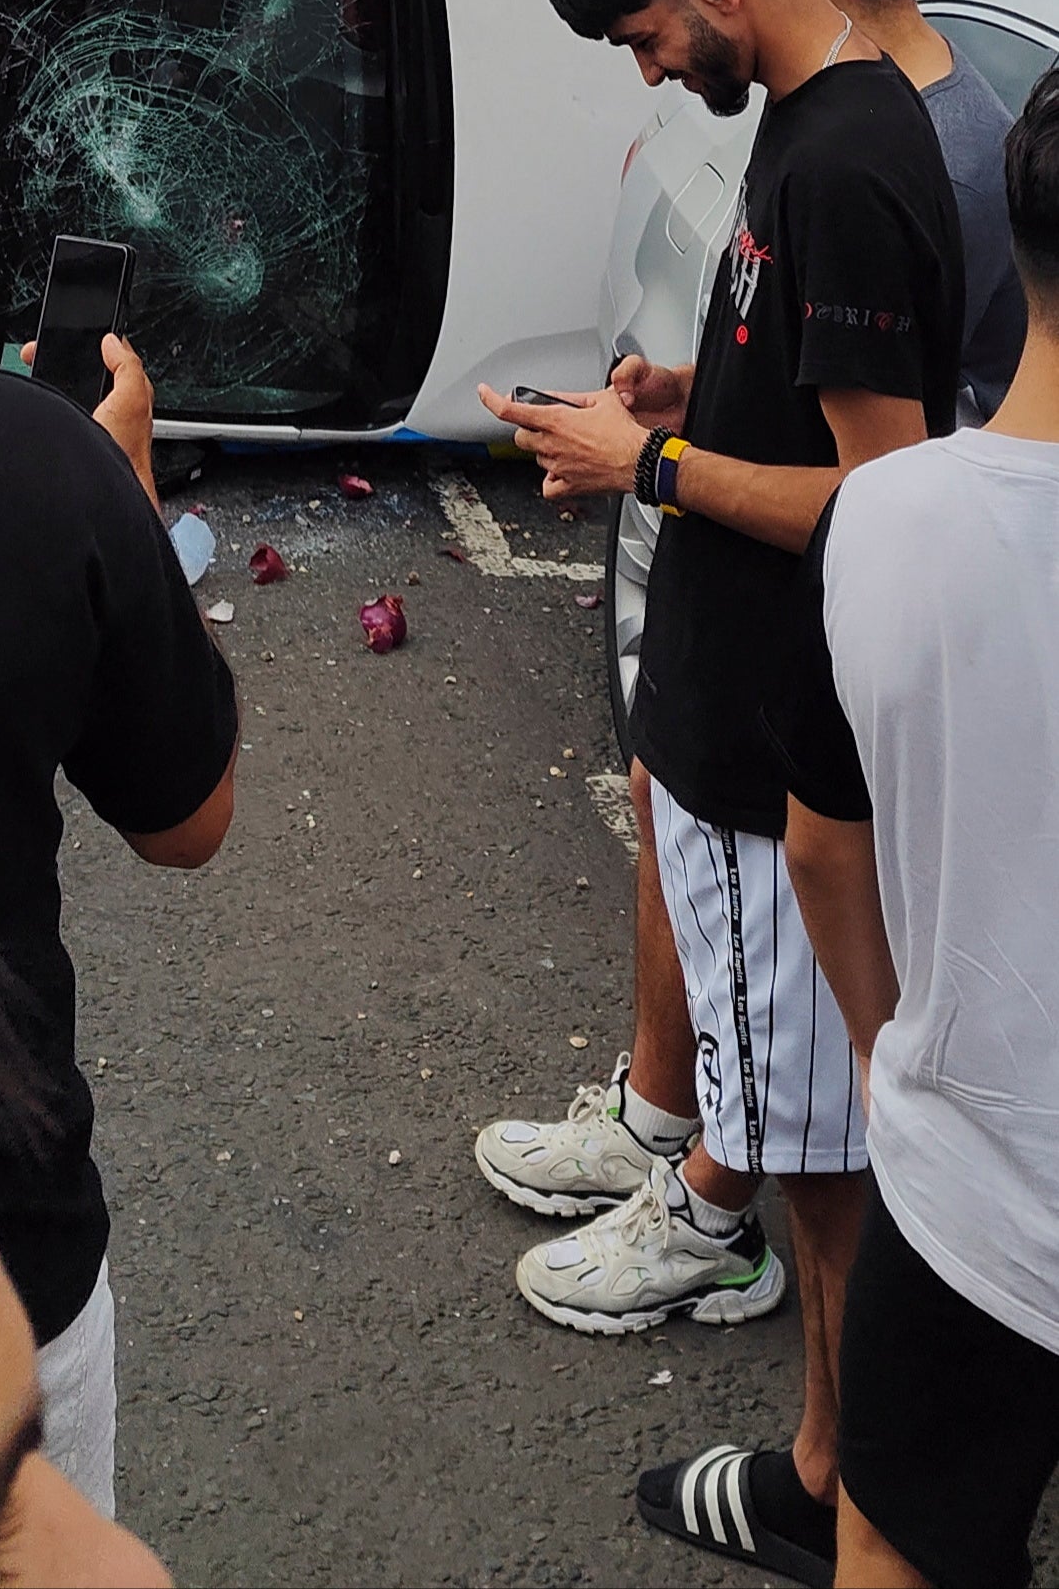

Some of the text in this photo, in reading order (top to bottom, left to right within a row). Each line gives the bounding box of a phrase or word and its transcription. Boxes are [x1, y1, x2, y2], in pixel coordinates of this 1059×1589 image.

[737, 995, 746, 1012] Los
[743, 1057, 752, 1074] Los
[748, 1119, 758, 1136] Los
